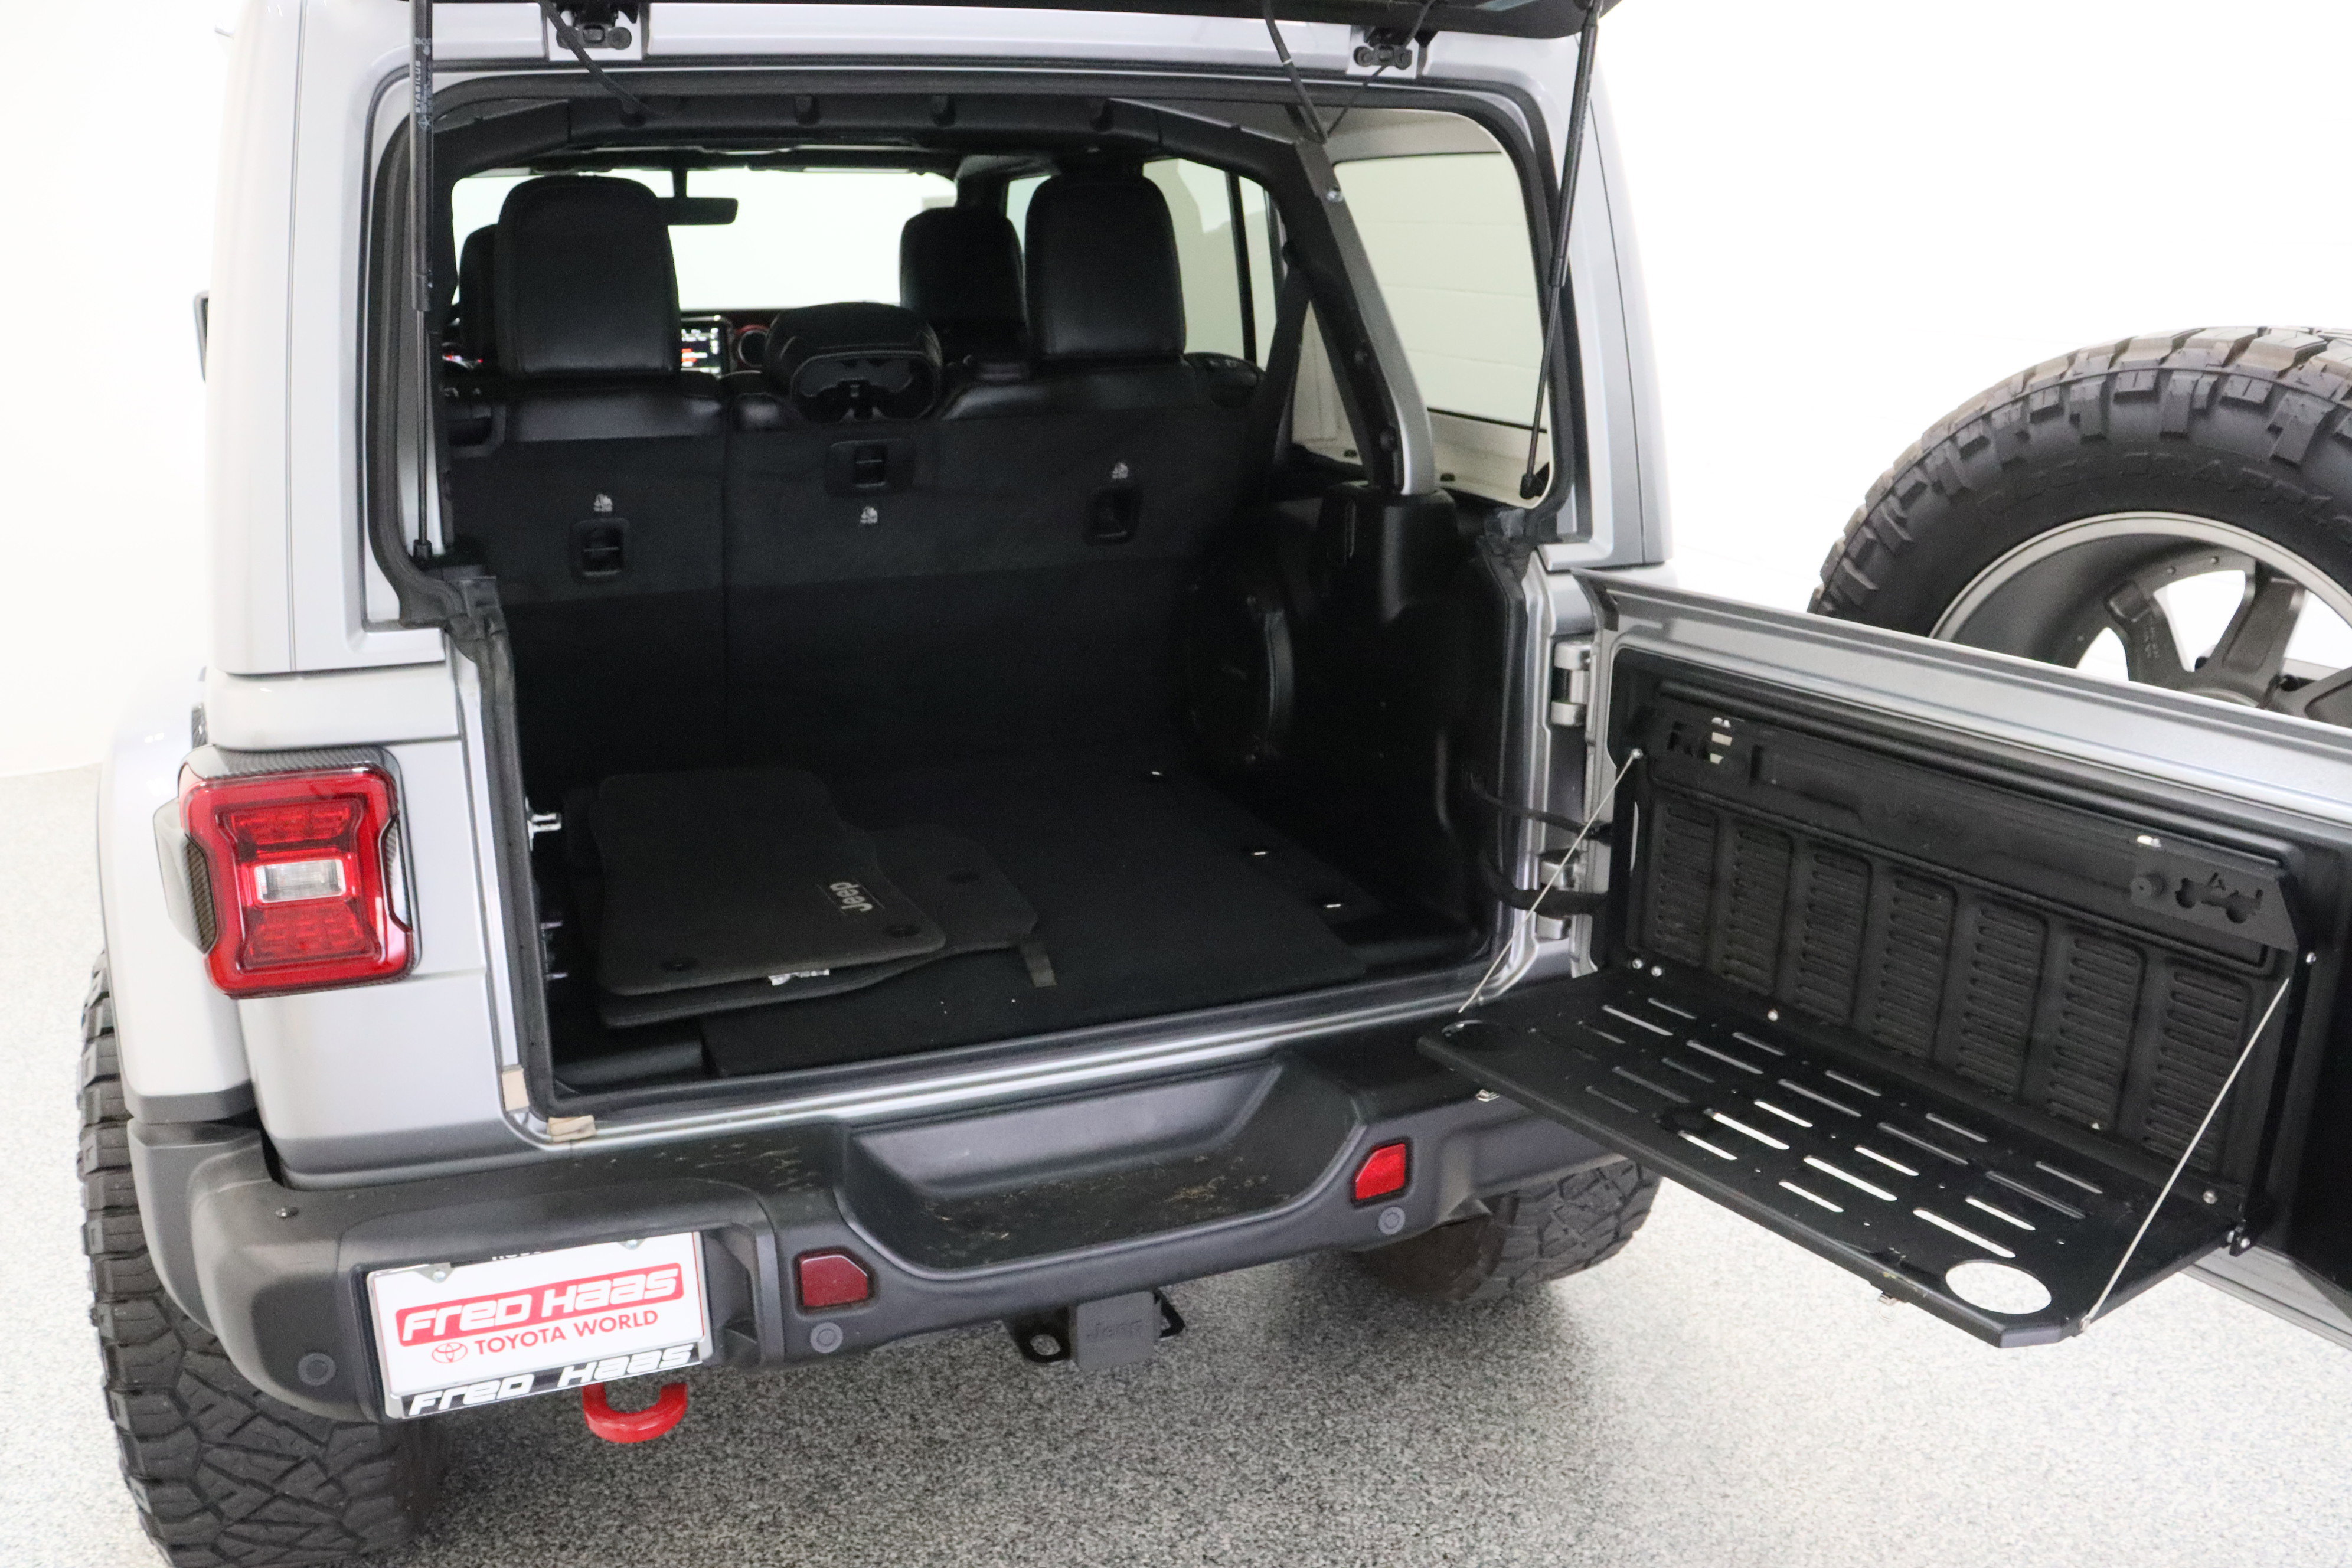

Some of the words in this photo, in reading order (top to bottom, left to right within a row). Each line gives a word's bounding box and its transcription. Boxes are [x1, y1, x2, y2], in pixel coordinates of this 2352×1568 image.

[829, 881, 873, 912] Jeep
[475, 1326, 567, 1355] TOYOTA
[573, 1309, 658, 1337] WORLD
